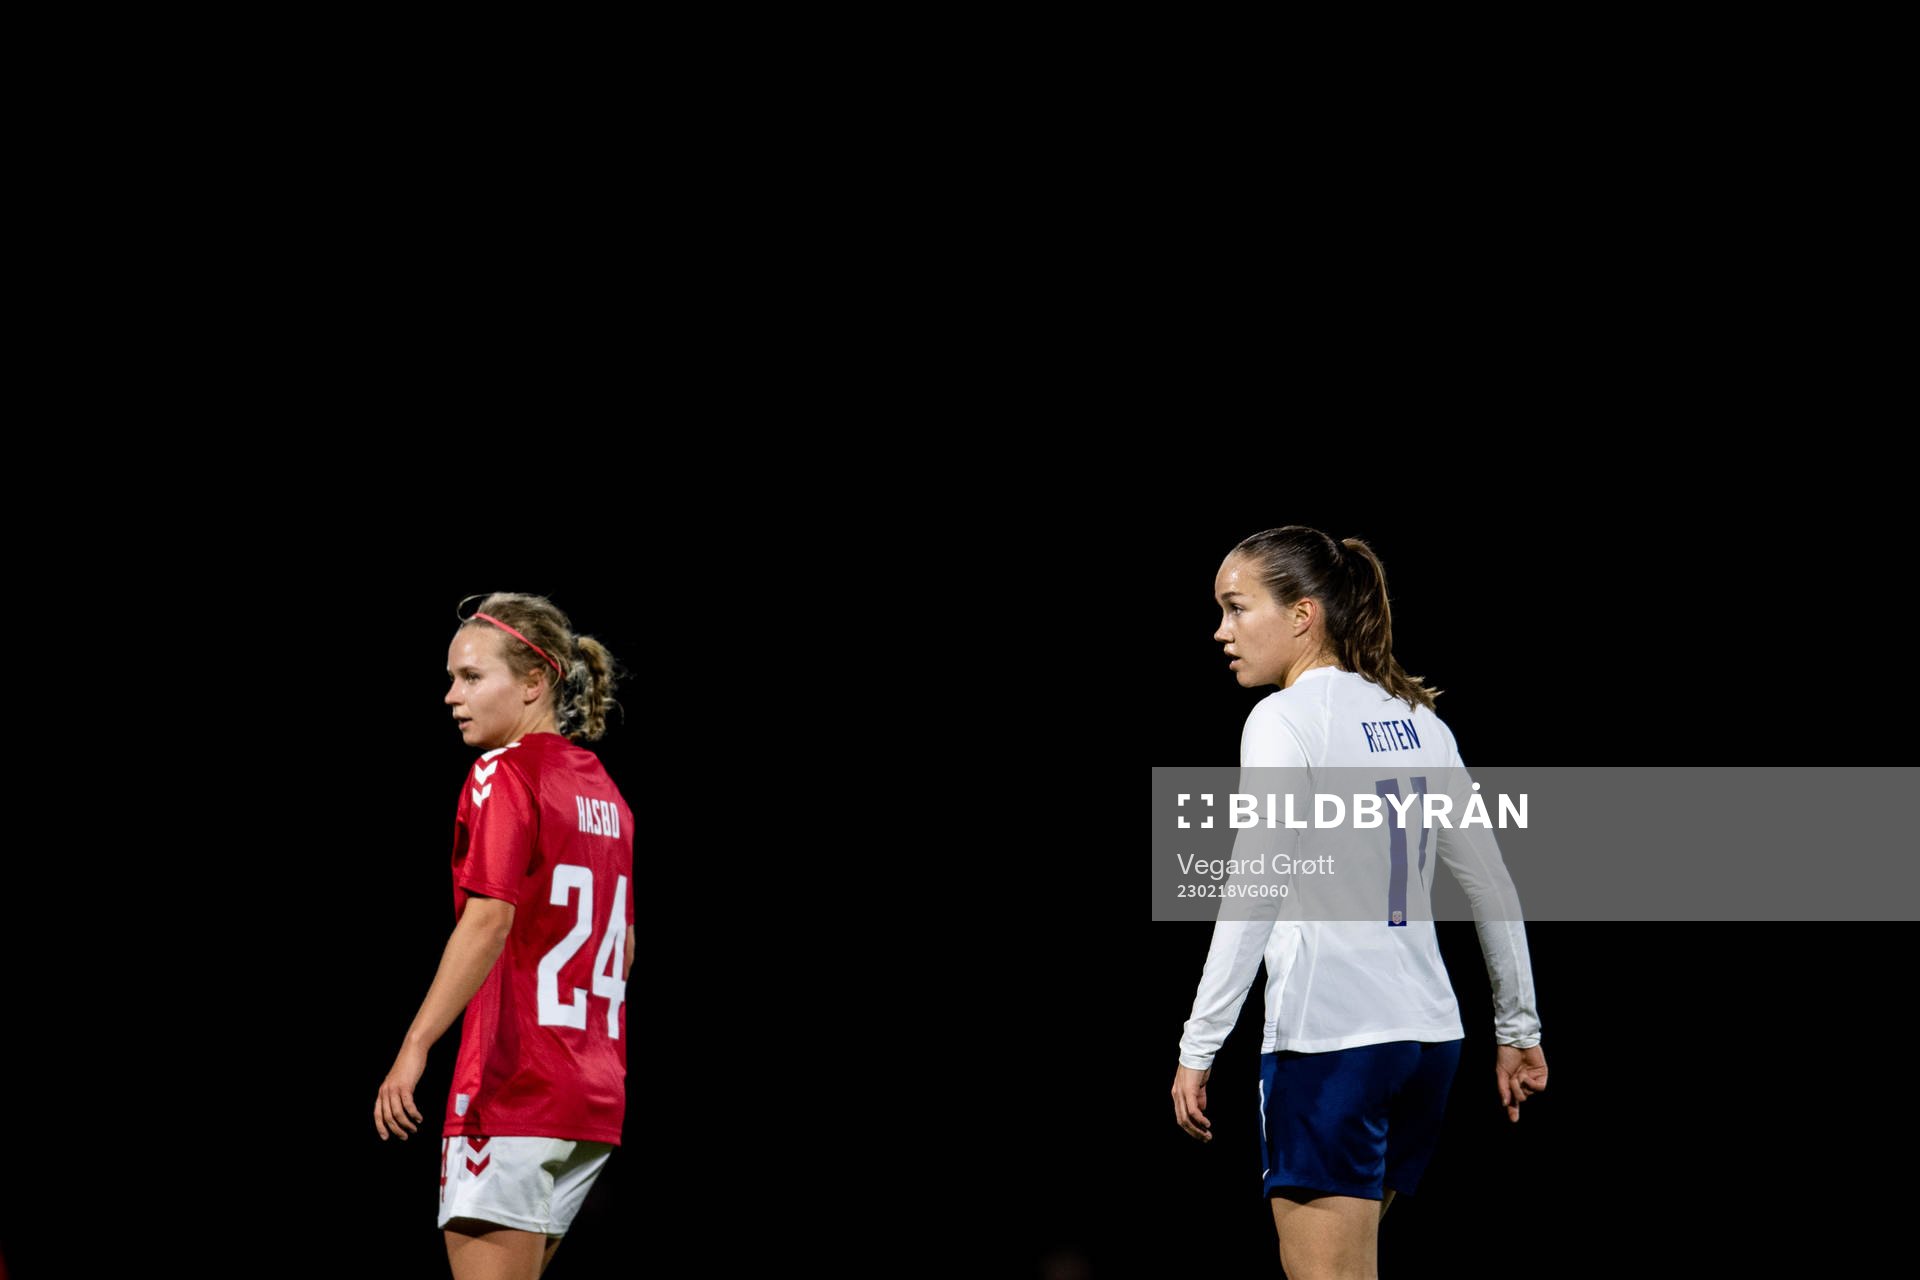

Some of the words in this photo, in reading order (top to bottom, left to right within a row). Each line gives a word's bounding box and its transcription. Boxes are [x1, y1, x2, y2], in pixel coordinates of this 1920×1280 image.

[1361, 718, 1421, 752] REITEN
[576, 795, 620, 839] HASBO
[537, 863, 628, 1040] 24
